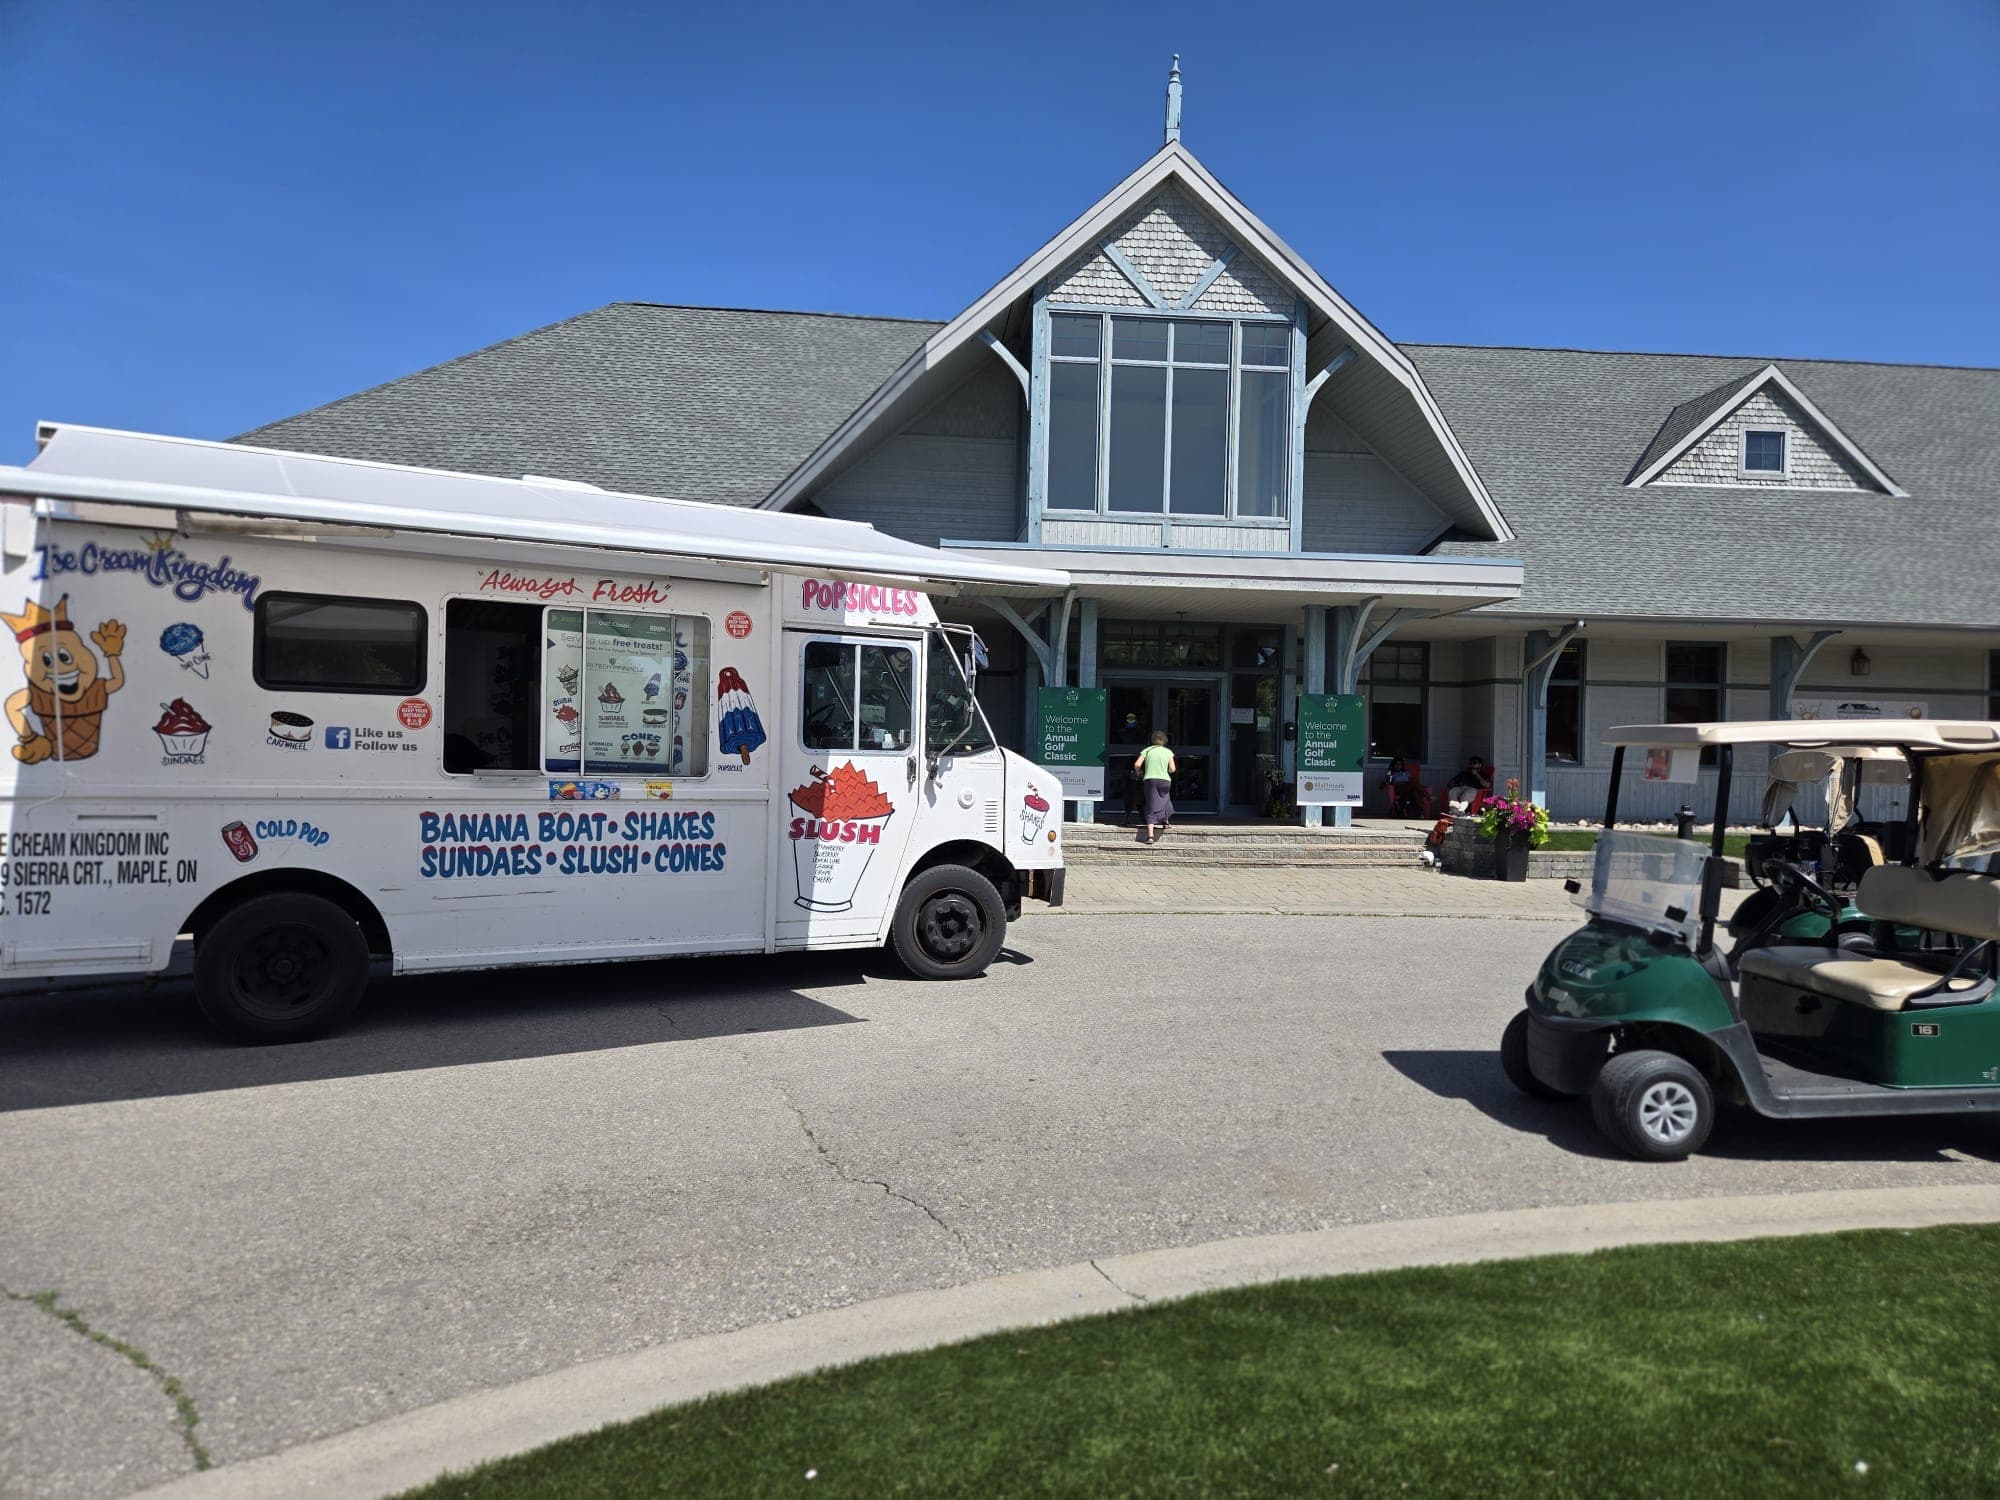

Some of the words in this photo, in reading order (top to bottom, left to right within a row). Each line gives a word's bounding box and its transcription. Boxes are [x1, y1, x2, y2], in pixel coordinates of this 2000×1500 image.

[80, 541, 163, 585] Cream
[153, 548, 261, 611] Kingdom
[802, 579, 918, 617] POPSICLES
[612, 638, 632, 648] free
[634, 640, 663, 651] treats!
[1045, 715, 1088, 724] Welcome
[1045, 725, 1054, 733] to
[1057, 724, 1072, 733] the
[1305, 722, 1347, 731] Welcome
[354, 728, 384, 738] Like
[387, 730, 403, 738] us
[621, 732, 662, 743] CONES
[1044, 734, 1078, 743] Annual
[1305, 731, 1314, 739] to
[1316, 731, 1331, 739] the
[266, 736, 309, 751] CARTWHEEL
[354, 740, 398, 751] Follow
[402, 742, 418, 751] us
[1044, 742, 1065, 751] Golf
[1304, 740, 1337, 749] Annual
[1044, 752, 1077, 760] Classic
[1304, 749, 1325, 757] Golf
[161, 756, 205, 766] SUNDAES
[1304, 758, 1336, 767] Classic
[1020, 809, 1045, 829] SHAKES
[419, 811, 530, 843] BANANA
[538, 811, 608, 843] BOAT
[621, 810, 715, 842] SHAKES
[788, 818, 881, 845] SLUSH
[255, 819, 298, 840] COLD
[298, 822, 330, 847] POP
[12, 832, 66, 857] CREAM
[70, 832, 141, 856] KINGDOM
[145, 832, 169, 856] INC
[420, 844, 543, 878] SUNDAES
[559, 844, 639, 875] SLUSH
[654, 842, 727, 872] CONES
[14, 862, 69, 886] SIERRA
[73, 861, 113, 888] CRT.,
[117, 860, 172, 887] MAPLE,
[176, 859, 197, 883] ON
[16, 890, 51, 916] 1572
[1918, 1025, 1933, 1035] 16
